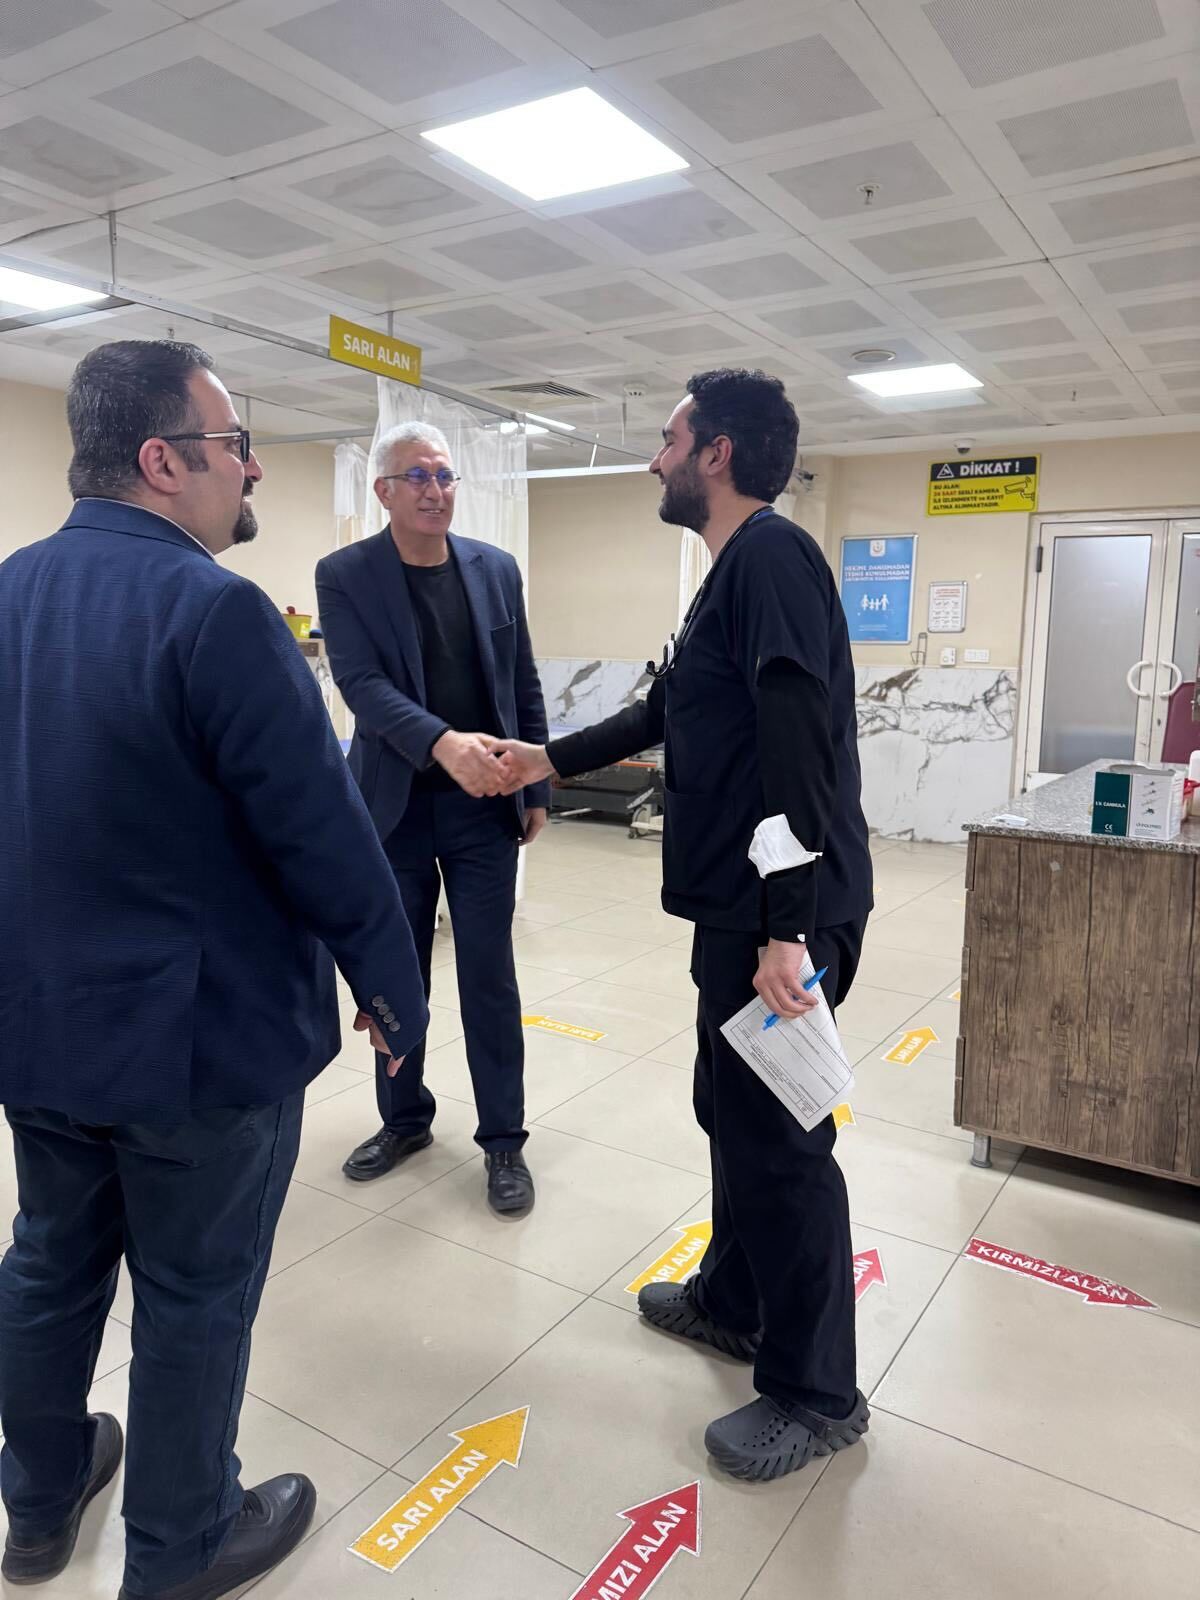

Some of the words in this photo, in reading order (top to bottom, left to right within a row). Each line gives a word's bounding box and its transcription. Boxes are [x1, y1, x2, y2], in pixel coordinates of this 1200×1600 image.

[343, 333, 374, 359] SARI
[378, 345, 410, 372] ALAN
[960, 461, 1011, 477] DİKKAT
[1015, 461, 1020, 473] !
[650, 1264, 678, 1283] ARI
[671, 1237, 706, 1267] ALAN
[977, 1245, 1061, 1279] KIRMIZI
[1064, 1276, 1129, 1301] ALAN
[377, 1500, 435, 1551] SARI
[429, 1448, 488, 1503] ALAN
[592, 1559, 642, 1600] MIZI
[633, 1501, 688, 1564] ALAN
